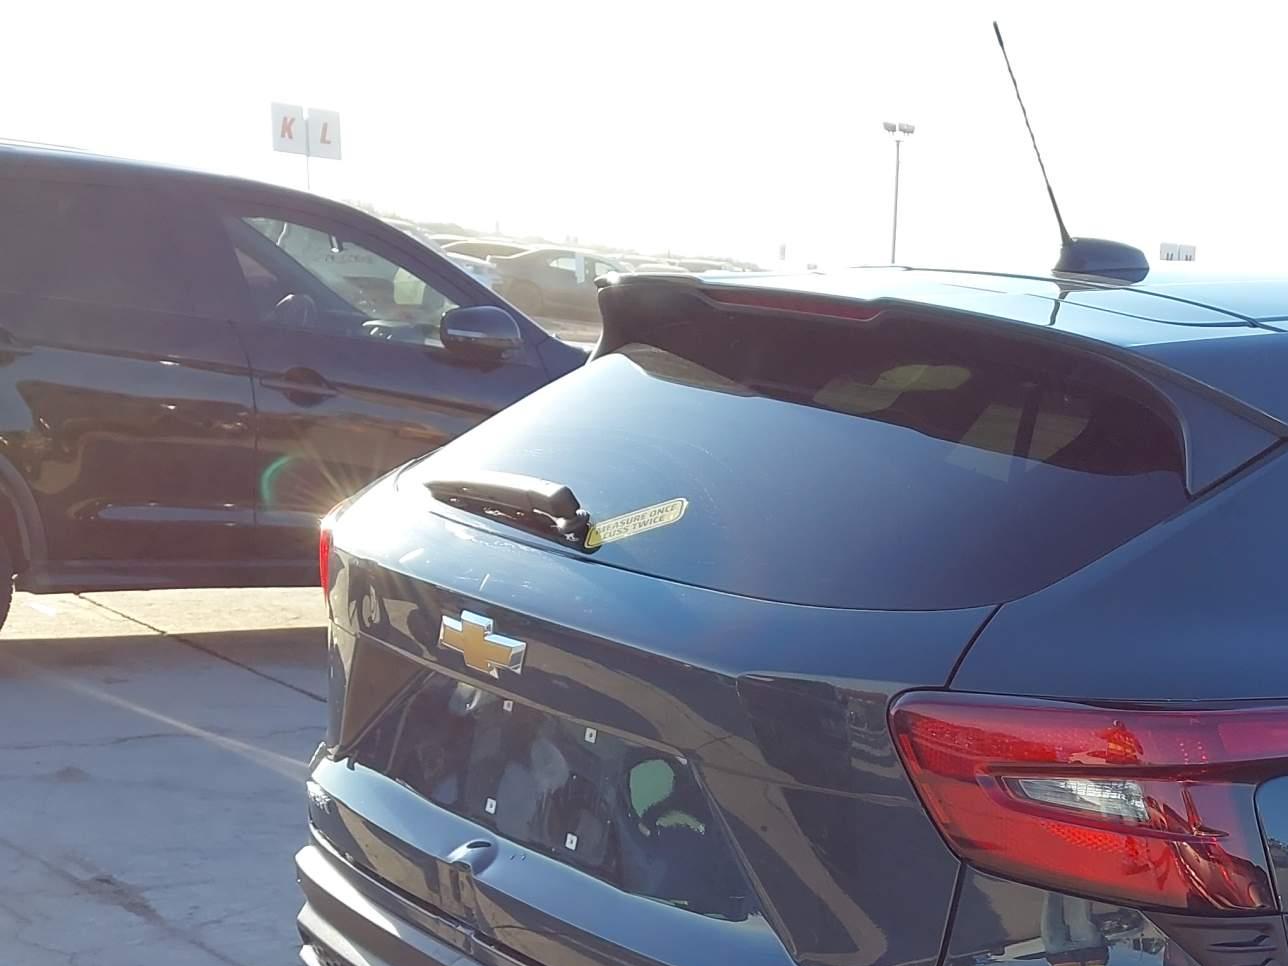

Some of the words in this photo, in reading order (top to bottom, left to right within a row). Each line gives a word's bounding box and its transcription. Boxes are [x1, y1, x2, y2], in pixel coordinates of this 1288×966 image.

[281, 116, 296, 139] K
[320, 122, 331, 144] L
[597, 513, 648, 533] MEASURE
[649, 503, 678, 516] ONCE
[602, 523, 630, 539] CUSS
[631, 515, 665, 530] TWICE
